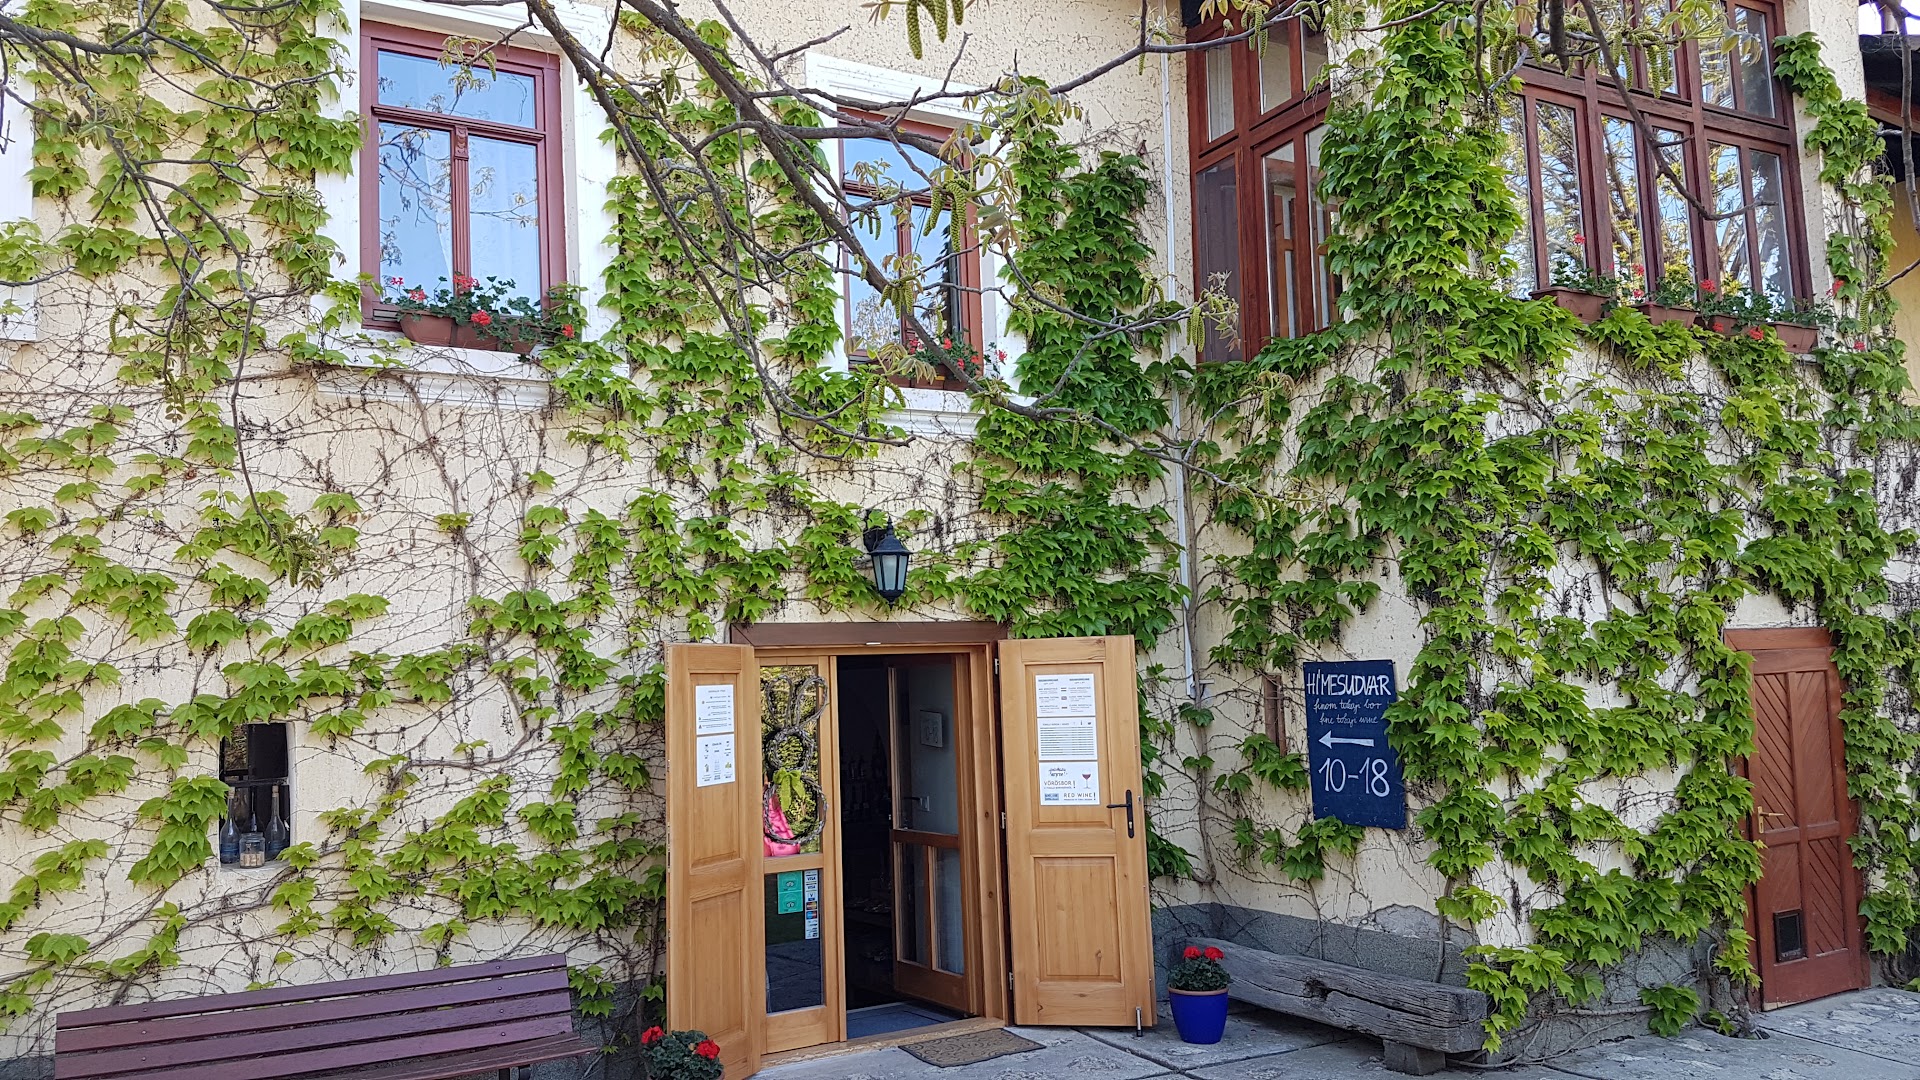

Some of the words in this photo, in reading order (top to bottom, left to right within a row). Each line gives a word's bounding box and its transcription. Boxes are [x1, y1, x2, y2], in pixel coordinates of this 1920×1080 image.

[1306, 669, 1392, 696] HÍMESUDVAR
[1313, 698, 1337, 714] finom
[1364, 699, 1383, 710] bor
[1319, 712, 1335, 726] fine
[1359, 716, 1379, 724] wine
[1318, 757, 1391, 798] 10-18
